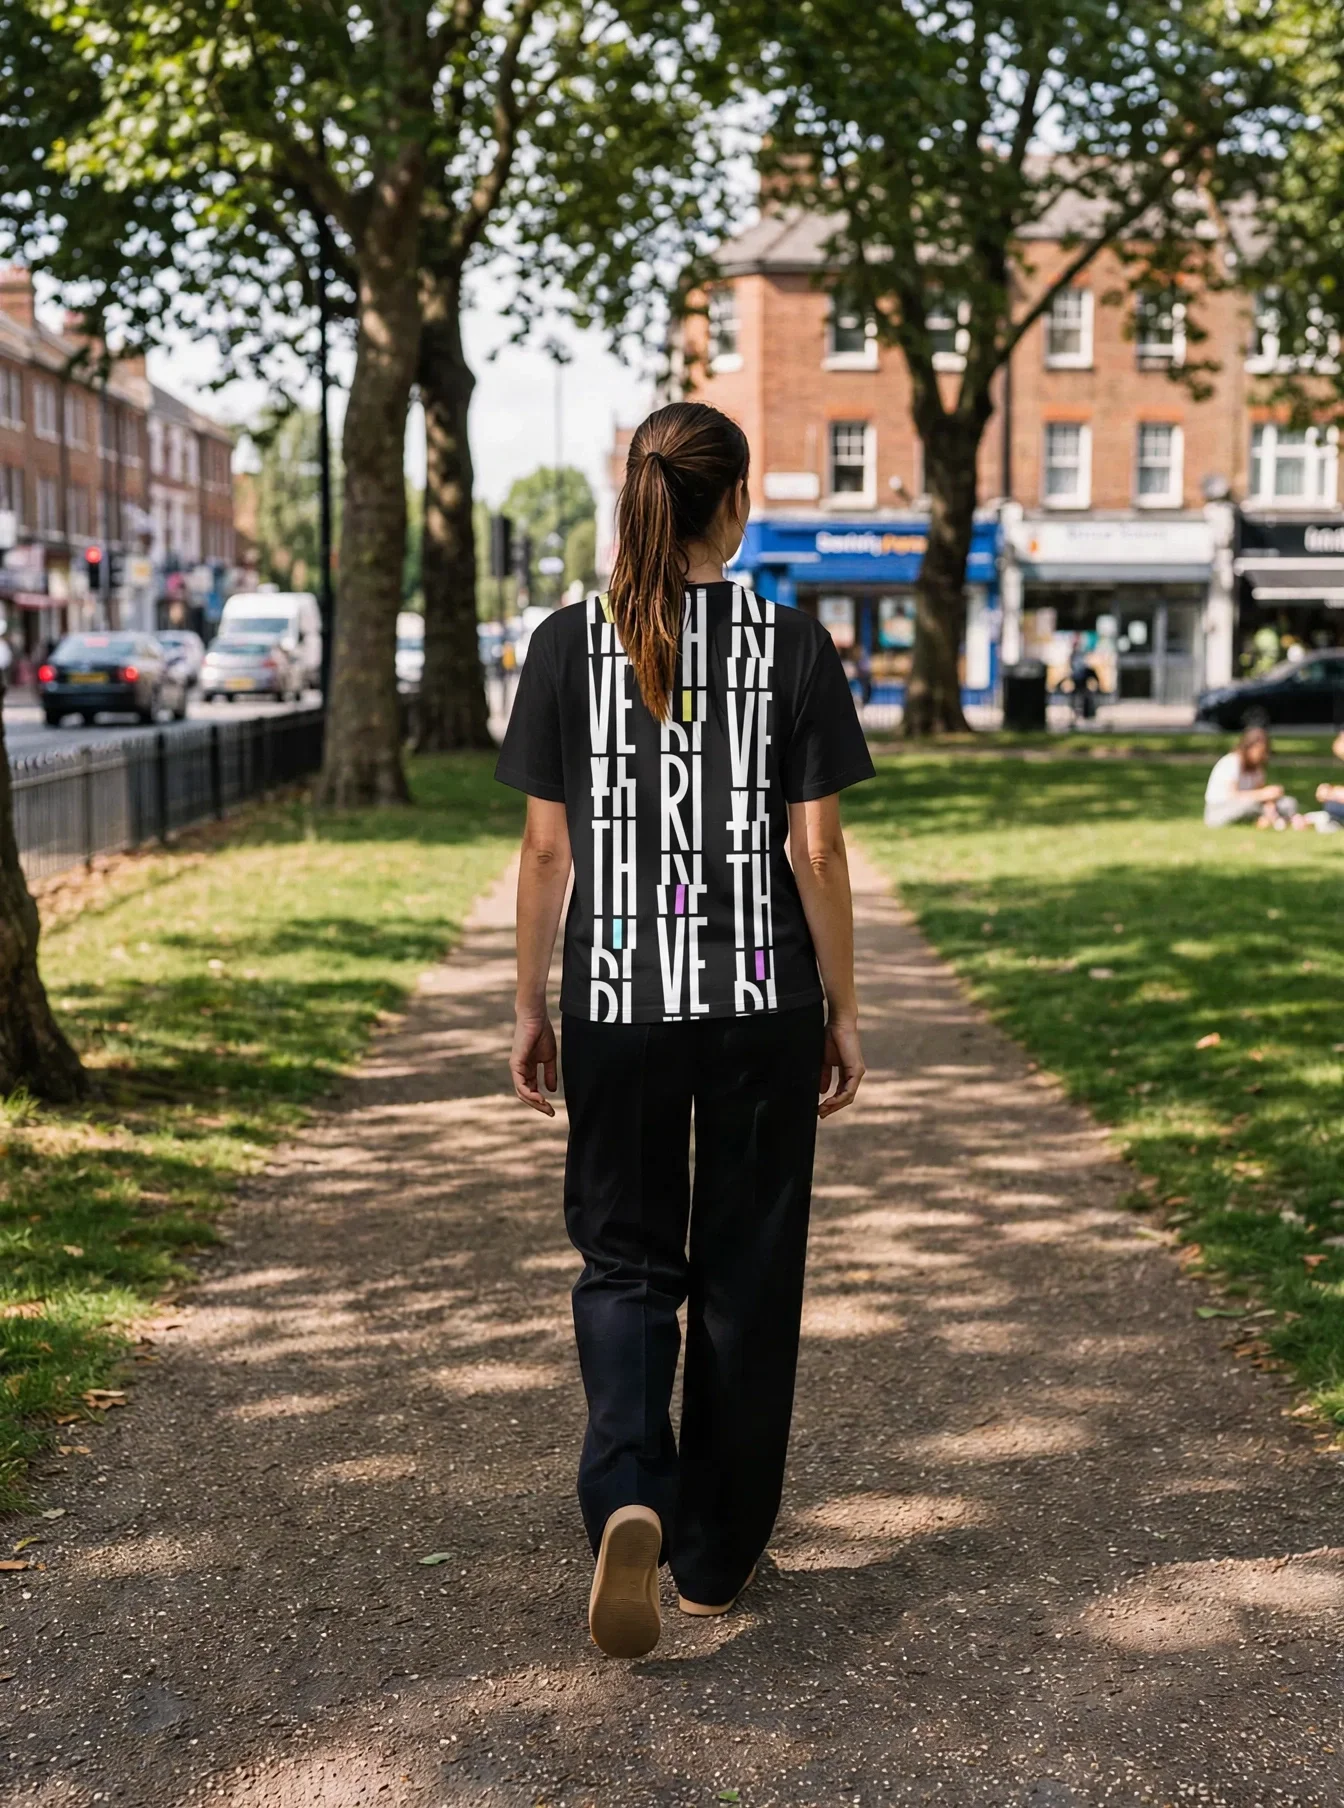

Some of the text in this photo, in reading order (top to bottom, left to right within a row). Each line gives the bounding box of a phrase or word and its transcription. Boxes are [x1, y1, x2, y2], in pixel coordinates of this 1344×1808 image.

[588, 657, 636, 754] VE
[727, 691, 773, 788] VE
[661, 754, 702, 851] RI
[592, 818, 637, 916] TH
[726, 853, 773, 949] TH
[657, 917, 710, 1014] VE
